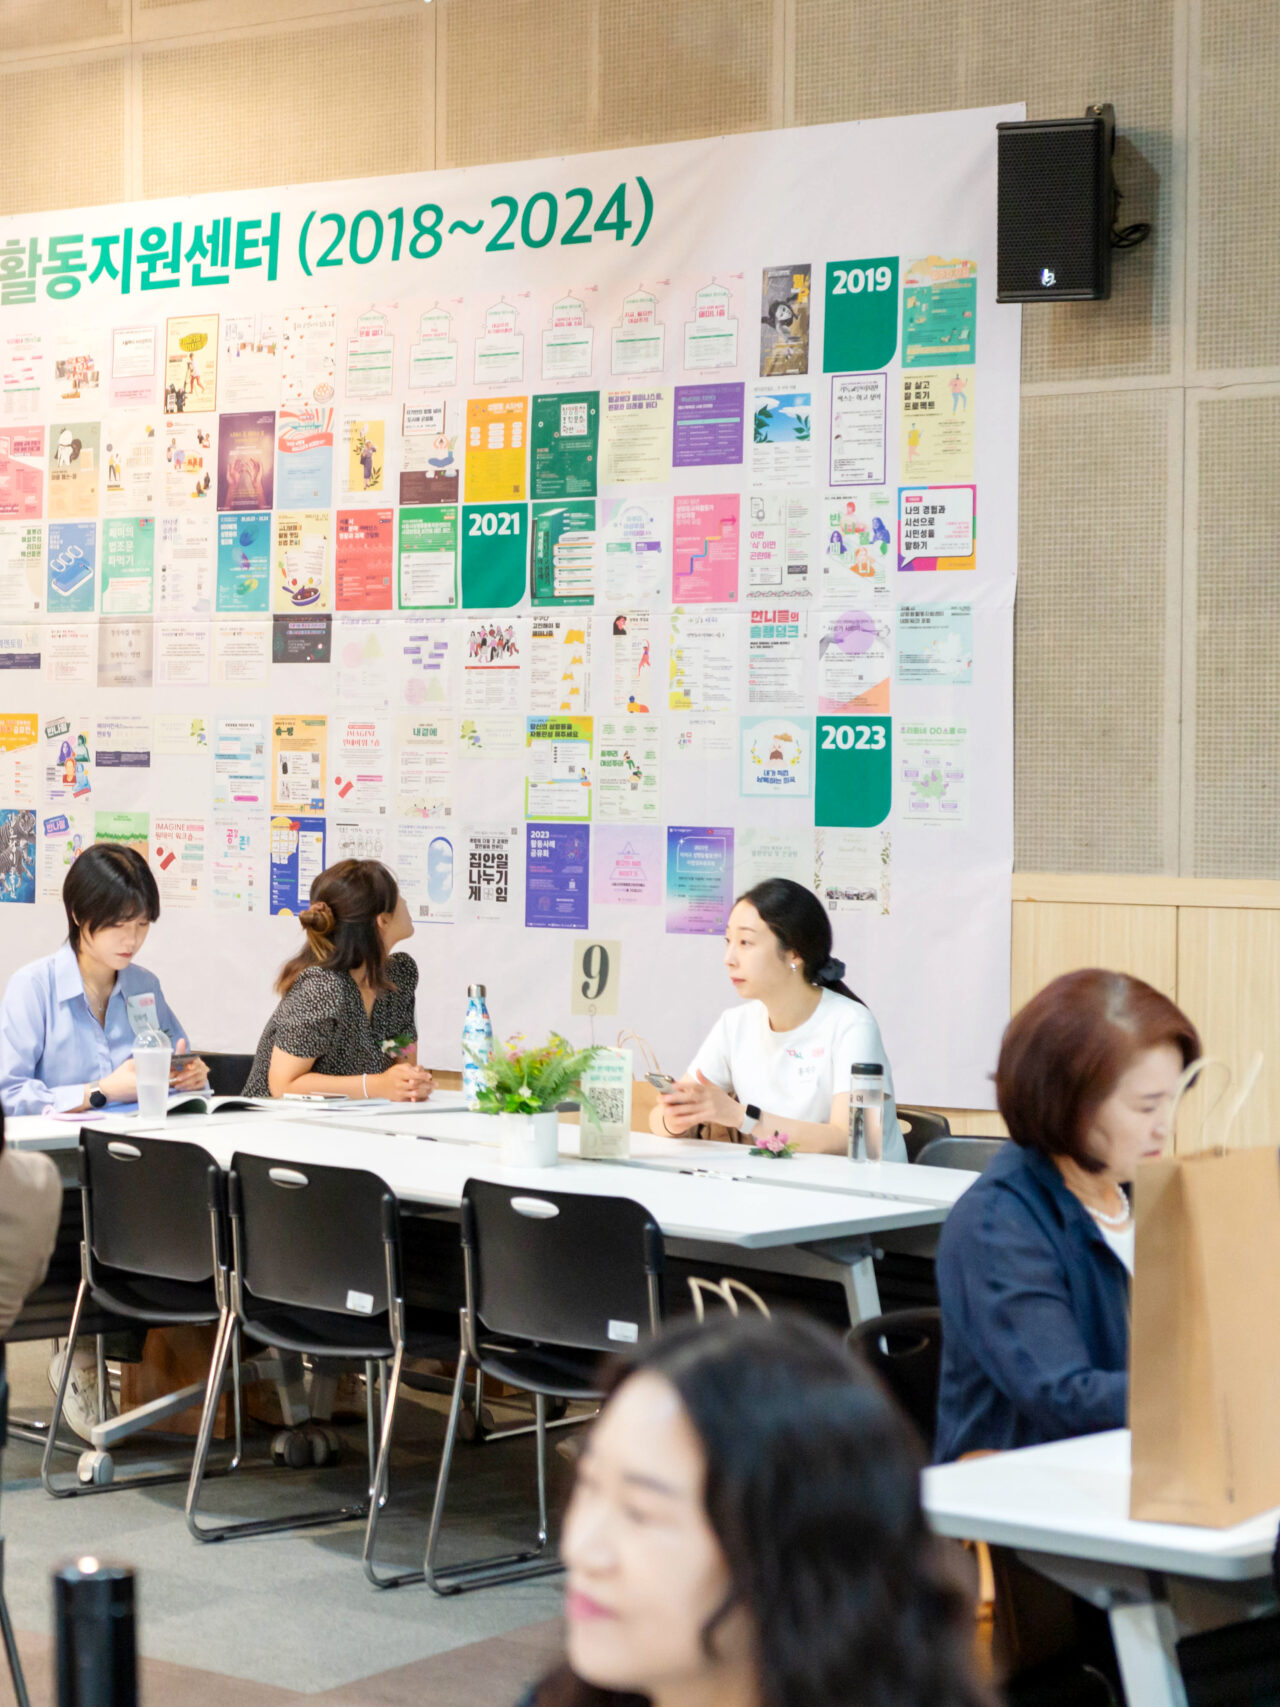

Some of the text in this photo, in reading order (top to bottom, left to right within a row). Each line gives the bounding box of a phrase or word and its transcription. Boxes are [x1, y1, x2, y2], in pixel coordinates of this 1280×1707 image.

[298, 176, 654, 276] (2018~2024)
[832, 266, 892, 295] 2019
[905, 505, 946, 515] 나의 경험과
[469, 512, 520, 536] 2021
[905, 517, 935, 527] 시선으로
[750, 610, 799, 624] 언니들의
[750, 625, 799, 638] 슬램덩크
[821, 725, 886, 750] 2023
[155, 823, 185, 831] IMAGINE
[530, 830, 550, 839] 2023
[469, 852, 509, 869] 집안일
[468, 869, 509, 886] 나누기
[468, 886, 508, 902] 게임
[581, 944, 610, 1000] 9
